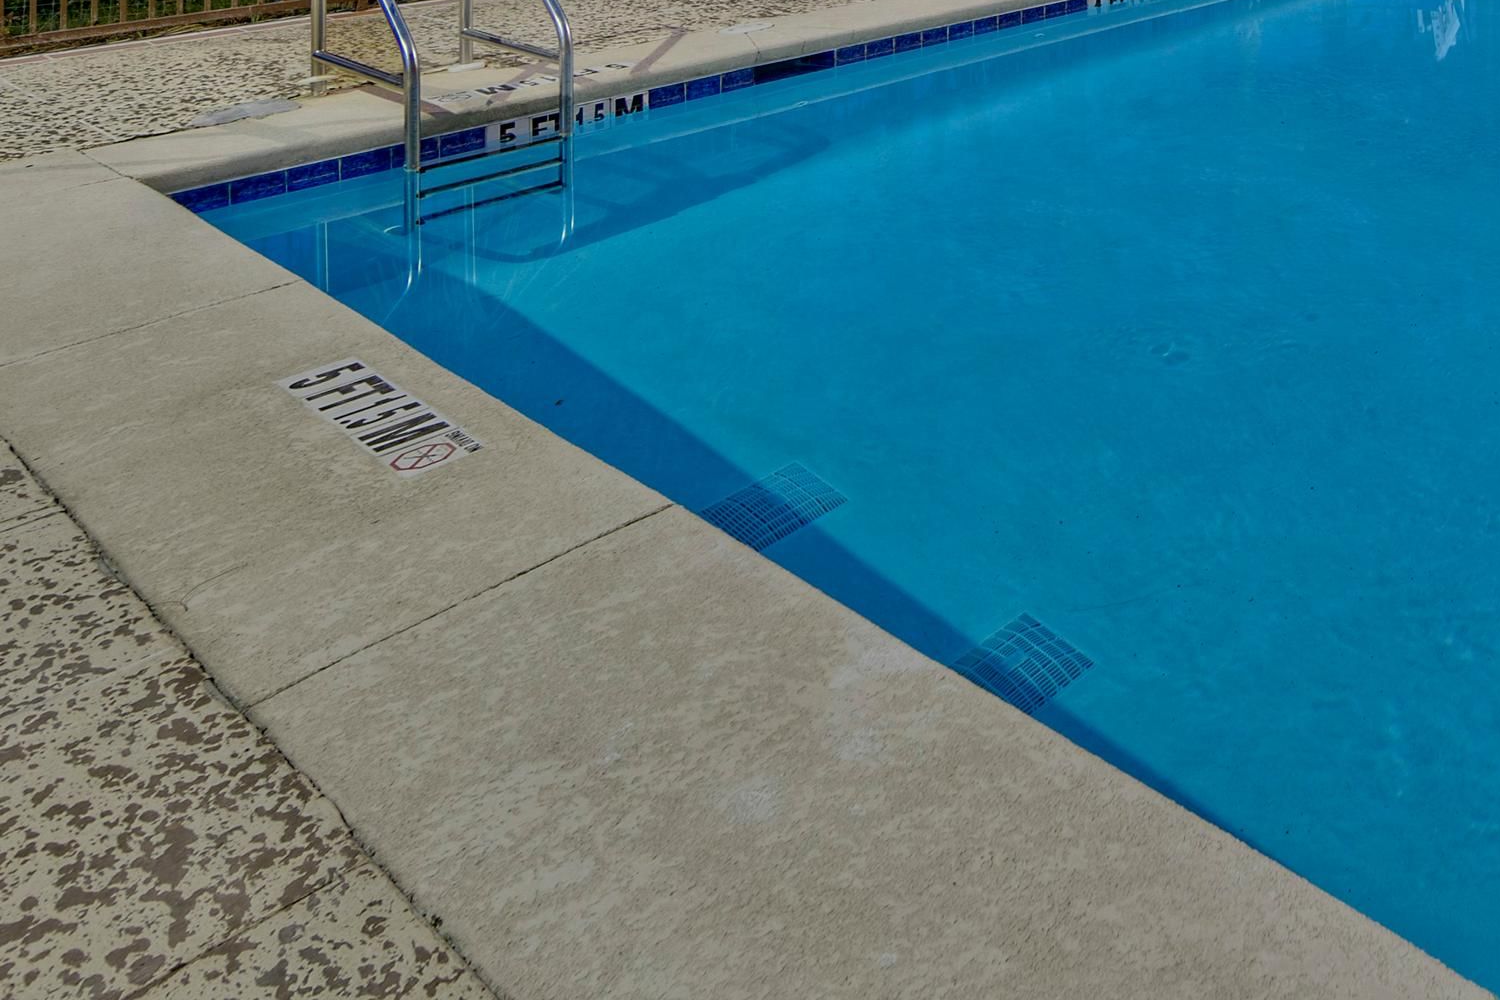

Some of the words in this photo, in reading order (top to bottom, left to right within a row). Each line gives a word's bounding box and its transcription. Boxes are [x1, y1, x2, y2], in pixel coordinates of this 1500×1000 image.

[499, 121, 516, 143] 5
[615, 93, 644, 117] M
[289, 362, 365, 389] 5
[305, 375, 396, 412] FT
[357, 412, 450, 453] M
